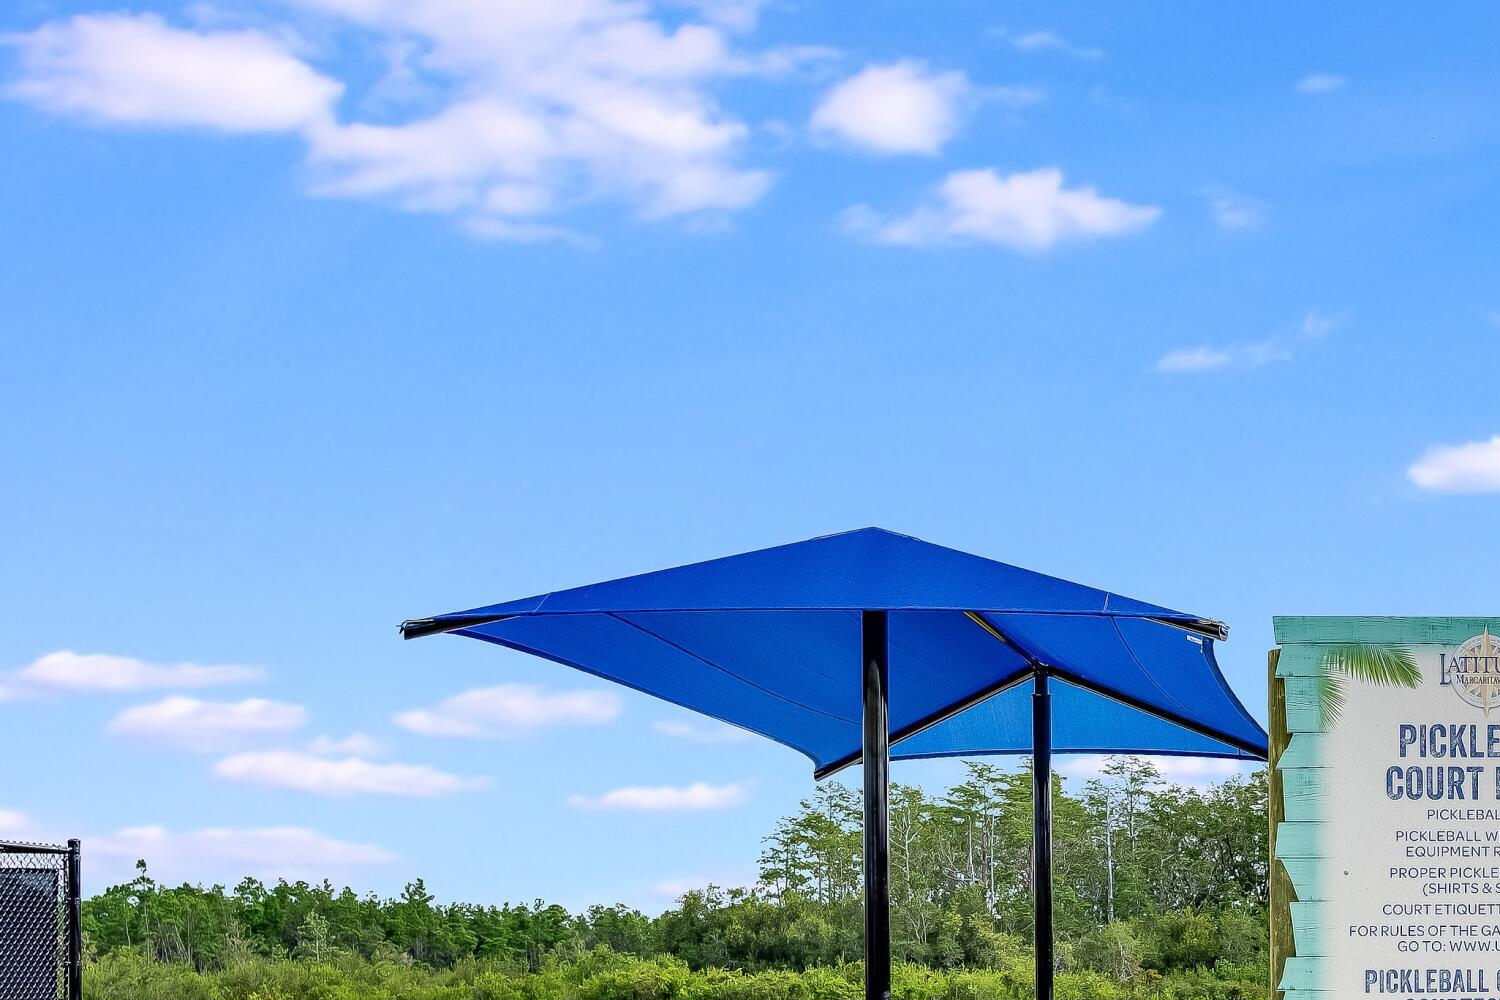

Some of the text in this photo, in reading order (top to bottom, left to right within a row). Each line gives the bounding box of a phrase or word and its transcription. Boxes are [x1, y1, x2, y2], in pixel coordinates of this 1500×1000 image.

[1385, 765, 1485, 801] COURT
[1395, 830, 1482, 843] PICKLEBALL
[1405, 845, 1491, 858] EQUIPMENT
[1389, 866, 1447, 879] PROPER
[1422, 882, 1480, 898] (SHIRTS
[1481, 882, 1493, 895] &
[1382, 903, 1433, 916] COURT
[1349, 924, 1378, 938] FOR
[1380, 924, 1425, 937] RULES
[1427, 924, 1448, 937] OF
[1449, 924, 1479, 937] THE
[1397, 939, 1420, 953] GO
[1421, 940, 1447, 953] TO:
[1364, 968, 1490, 994] PICKLEBALL
